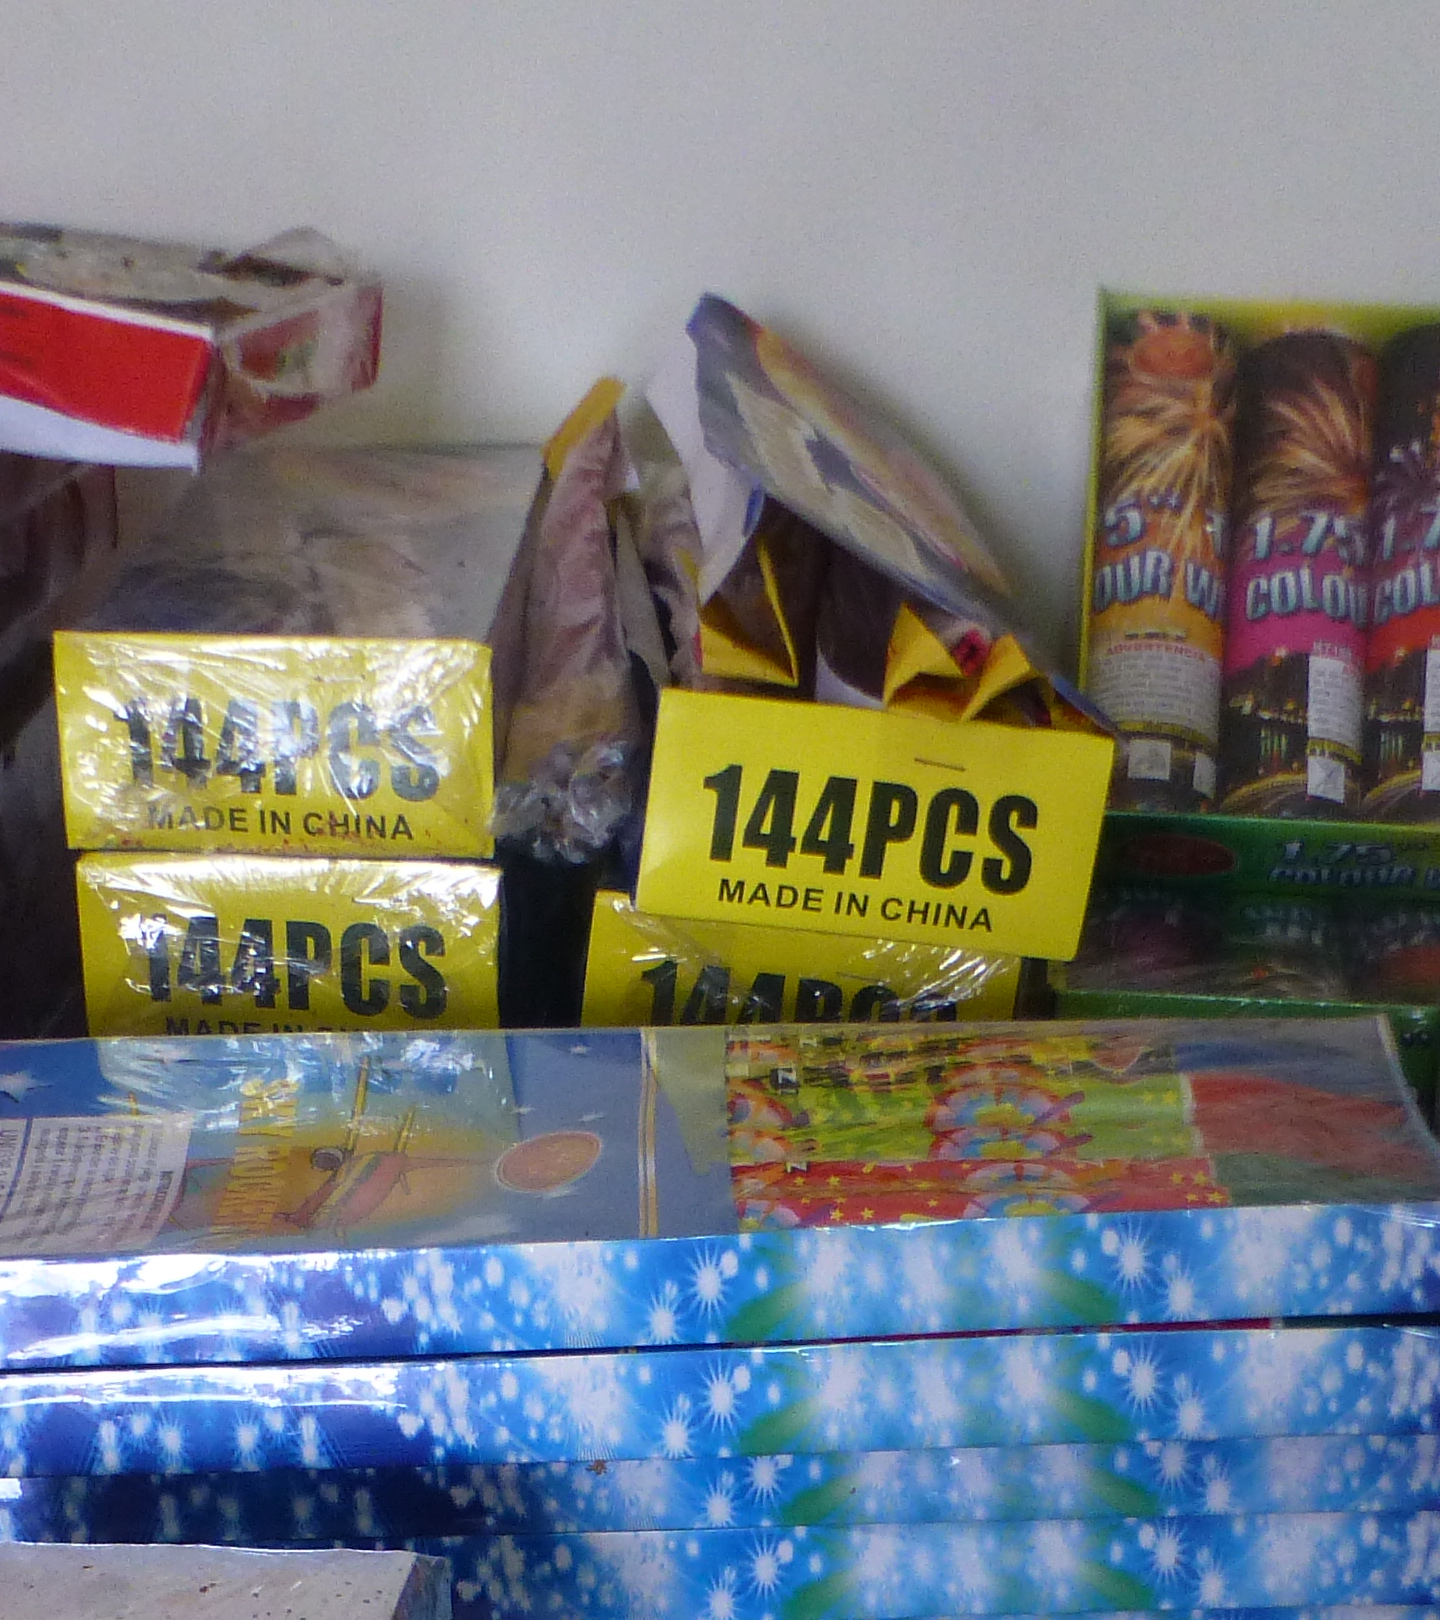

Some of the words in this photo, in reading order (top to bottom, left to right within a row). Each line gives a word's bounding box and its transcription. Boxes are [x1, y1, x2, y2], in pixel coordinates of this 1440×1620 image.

[119, 693, 447, 805] 144PCS
[146, 805, 251, 834] MADE
[257, 807, 296, 837] IN
[302, 811, 415, 843] CHINA
[700, 761, 1038, 897] 144PCS
[716, 876, 827, 914] MADE
[832, 889, 872, 919] IN
[879, 896, 994, 936] CHINA
[143, 911, 447, 1020] 144PCS
